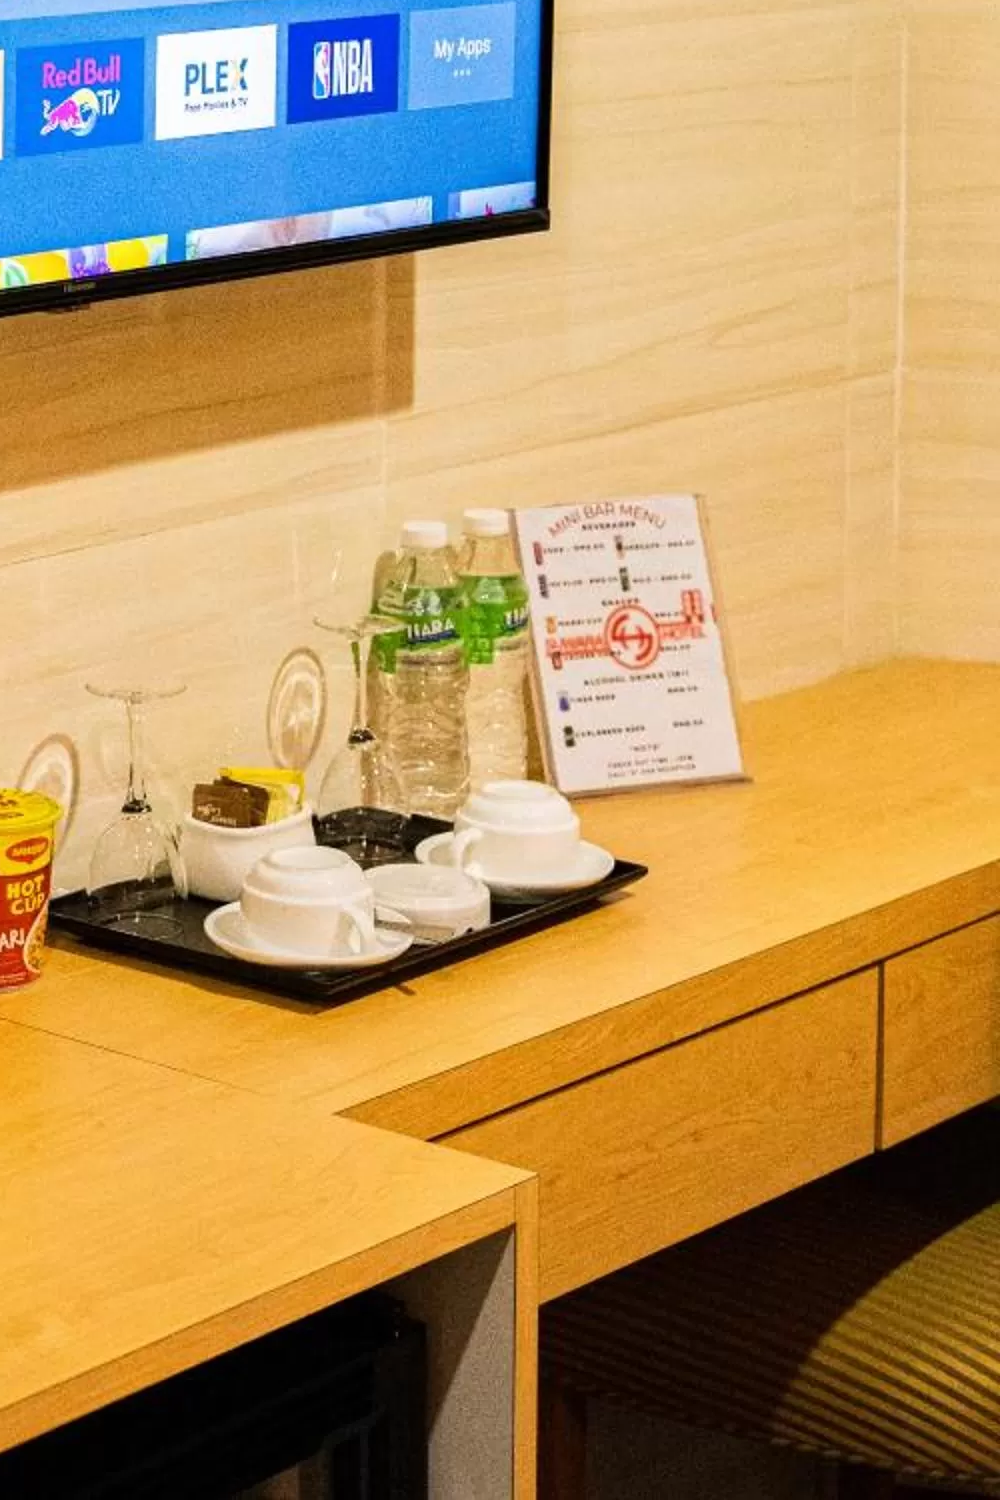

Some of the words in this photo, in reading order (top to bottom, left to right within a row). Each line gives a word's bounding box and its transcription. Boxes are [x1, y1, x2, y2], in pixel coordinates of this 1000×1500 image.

[433, 39, 454, 63] My
[457, 37, 491, 61] Apps
[42, 58, 81, 89] Red
[83, 55, 121, 86] Bull
[184, 58, 248, 97] PLEX
[332, 39, 373, 96] NBA
[98, 88, 121, 116] TV
[548, 507, 581, 537] MINI
[583, 501, 615, 518] BAR
[620, 503, 667, 529] MENU
[6, 873, 45, 900] HOT
[10, 892, 45, 915] CUP
